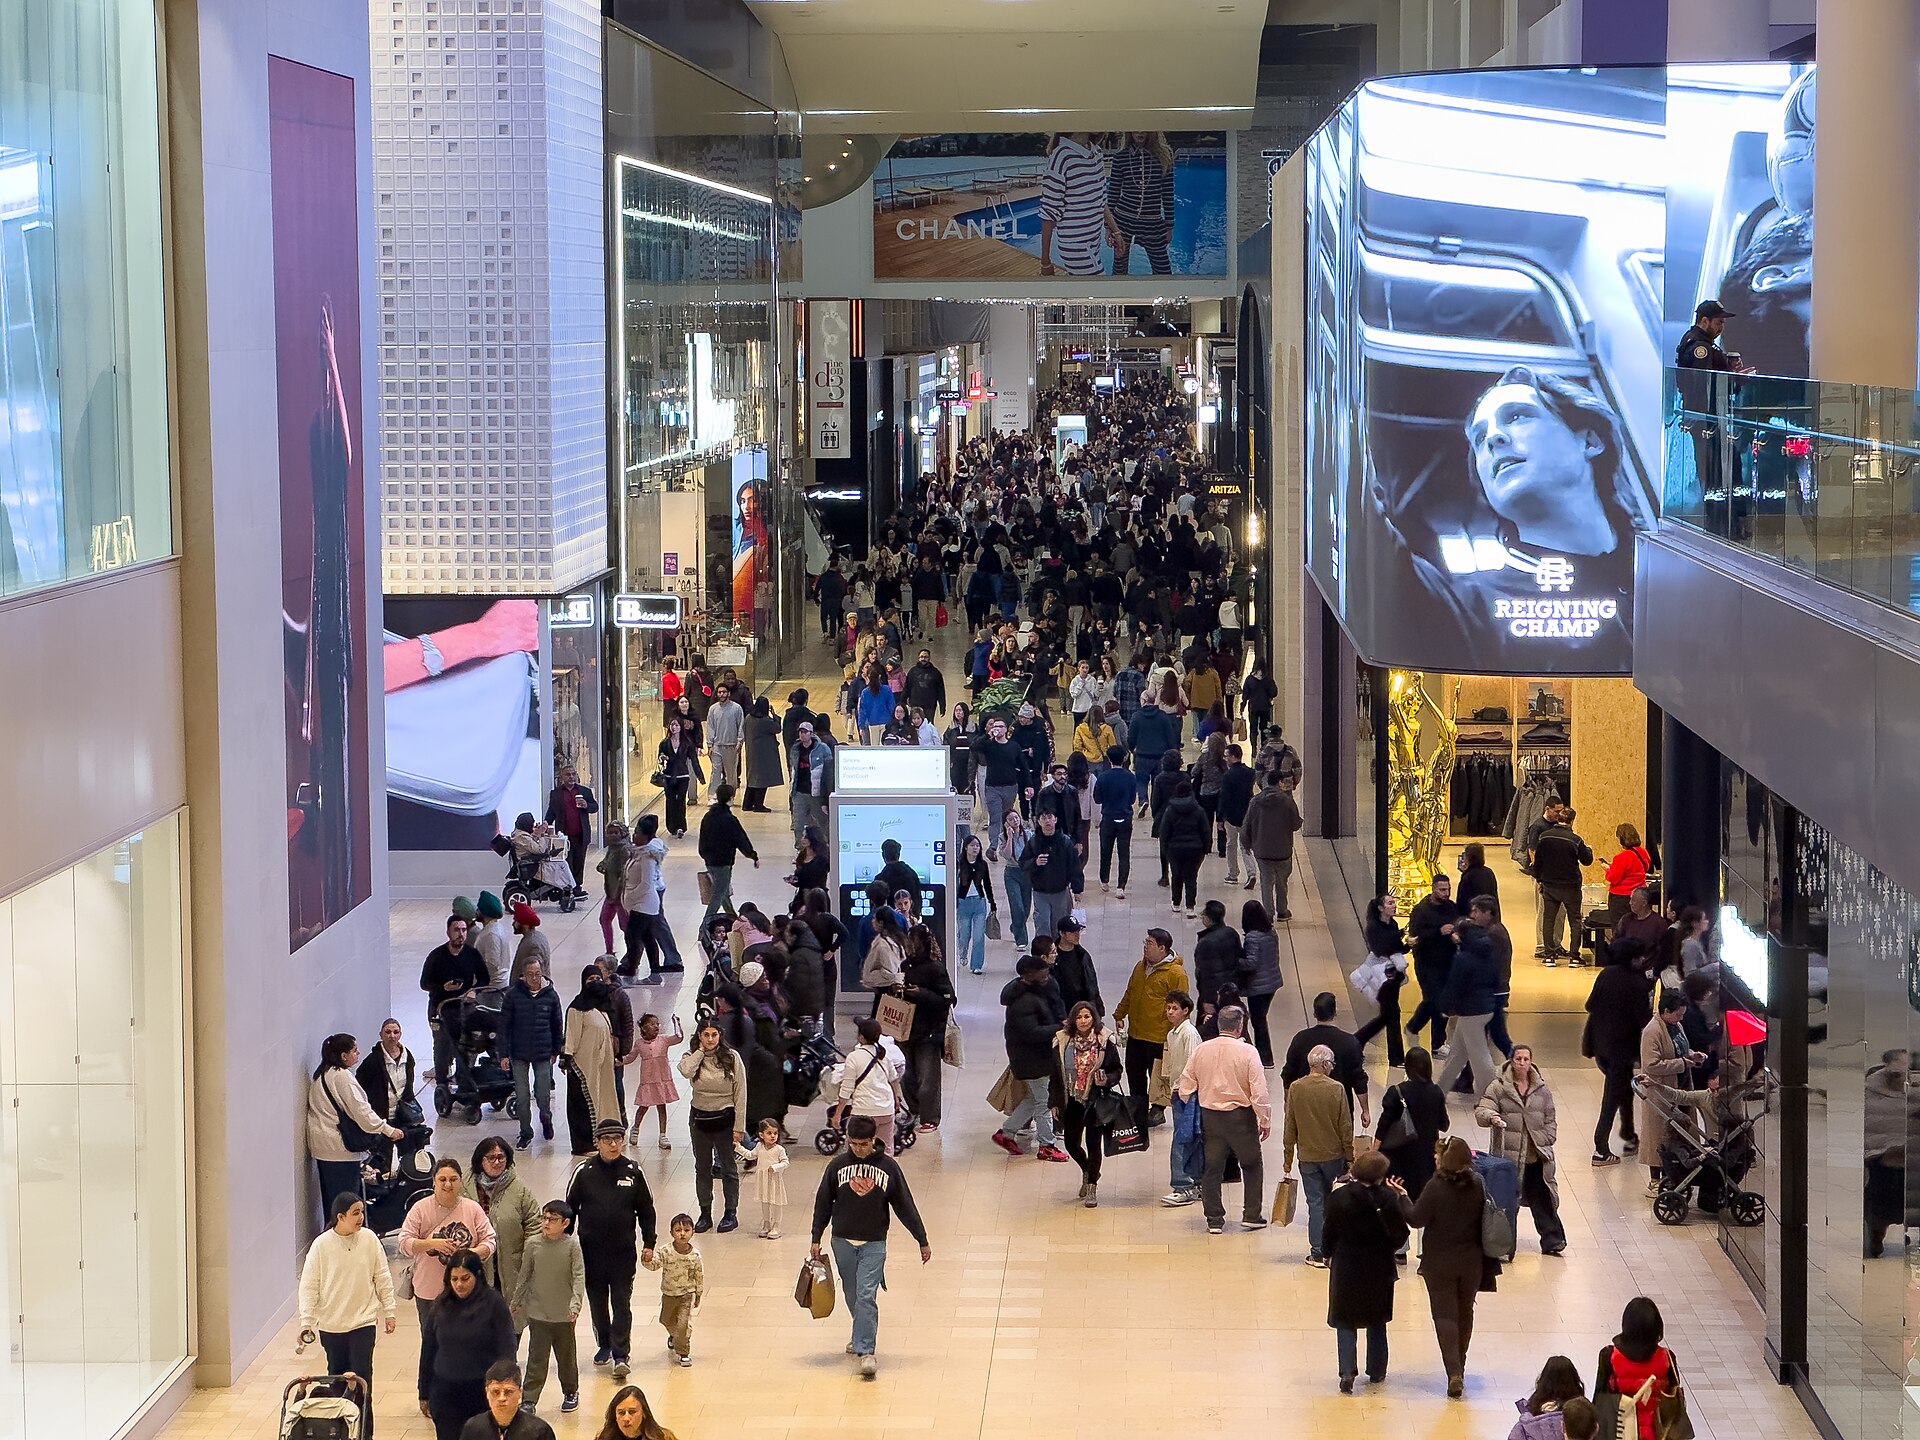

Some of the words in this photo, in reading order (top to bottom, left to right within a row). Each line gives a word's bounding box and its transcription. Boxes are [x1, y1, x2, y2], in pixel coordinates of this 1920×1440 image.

[895, 219, 1028, 241] CHANEL
[829, 375, 845, 400] 3
[1208, 485, 1241, 494] ARITZIA
[617, 600, 676, 622] Browns
[1494, 599, 1617, 619] REIGNING
[1510, 619, 1600, 638] CHAMP
[883, 1006, 904, 1022] MUJI
[837, 1164, 890, 1193] CHINATOWN
